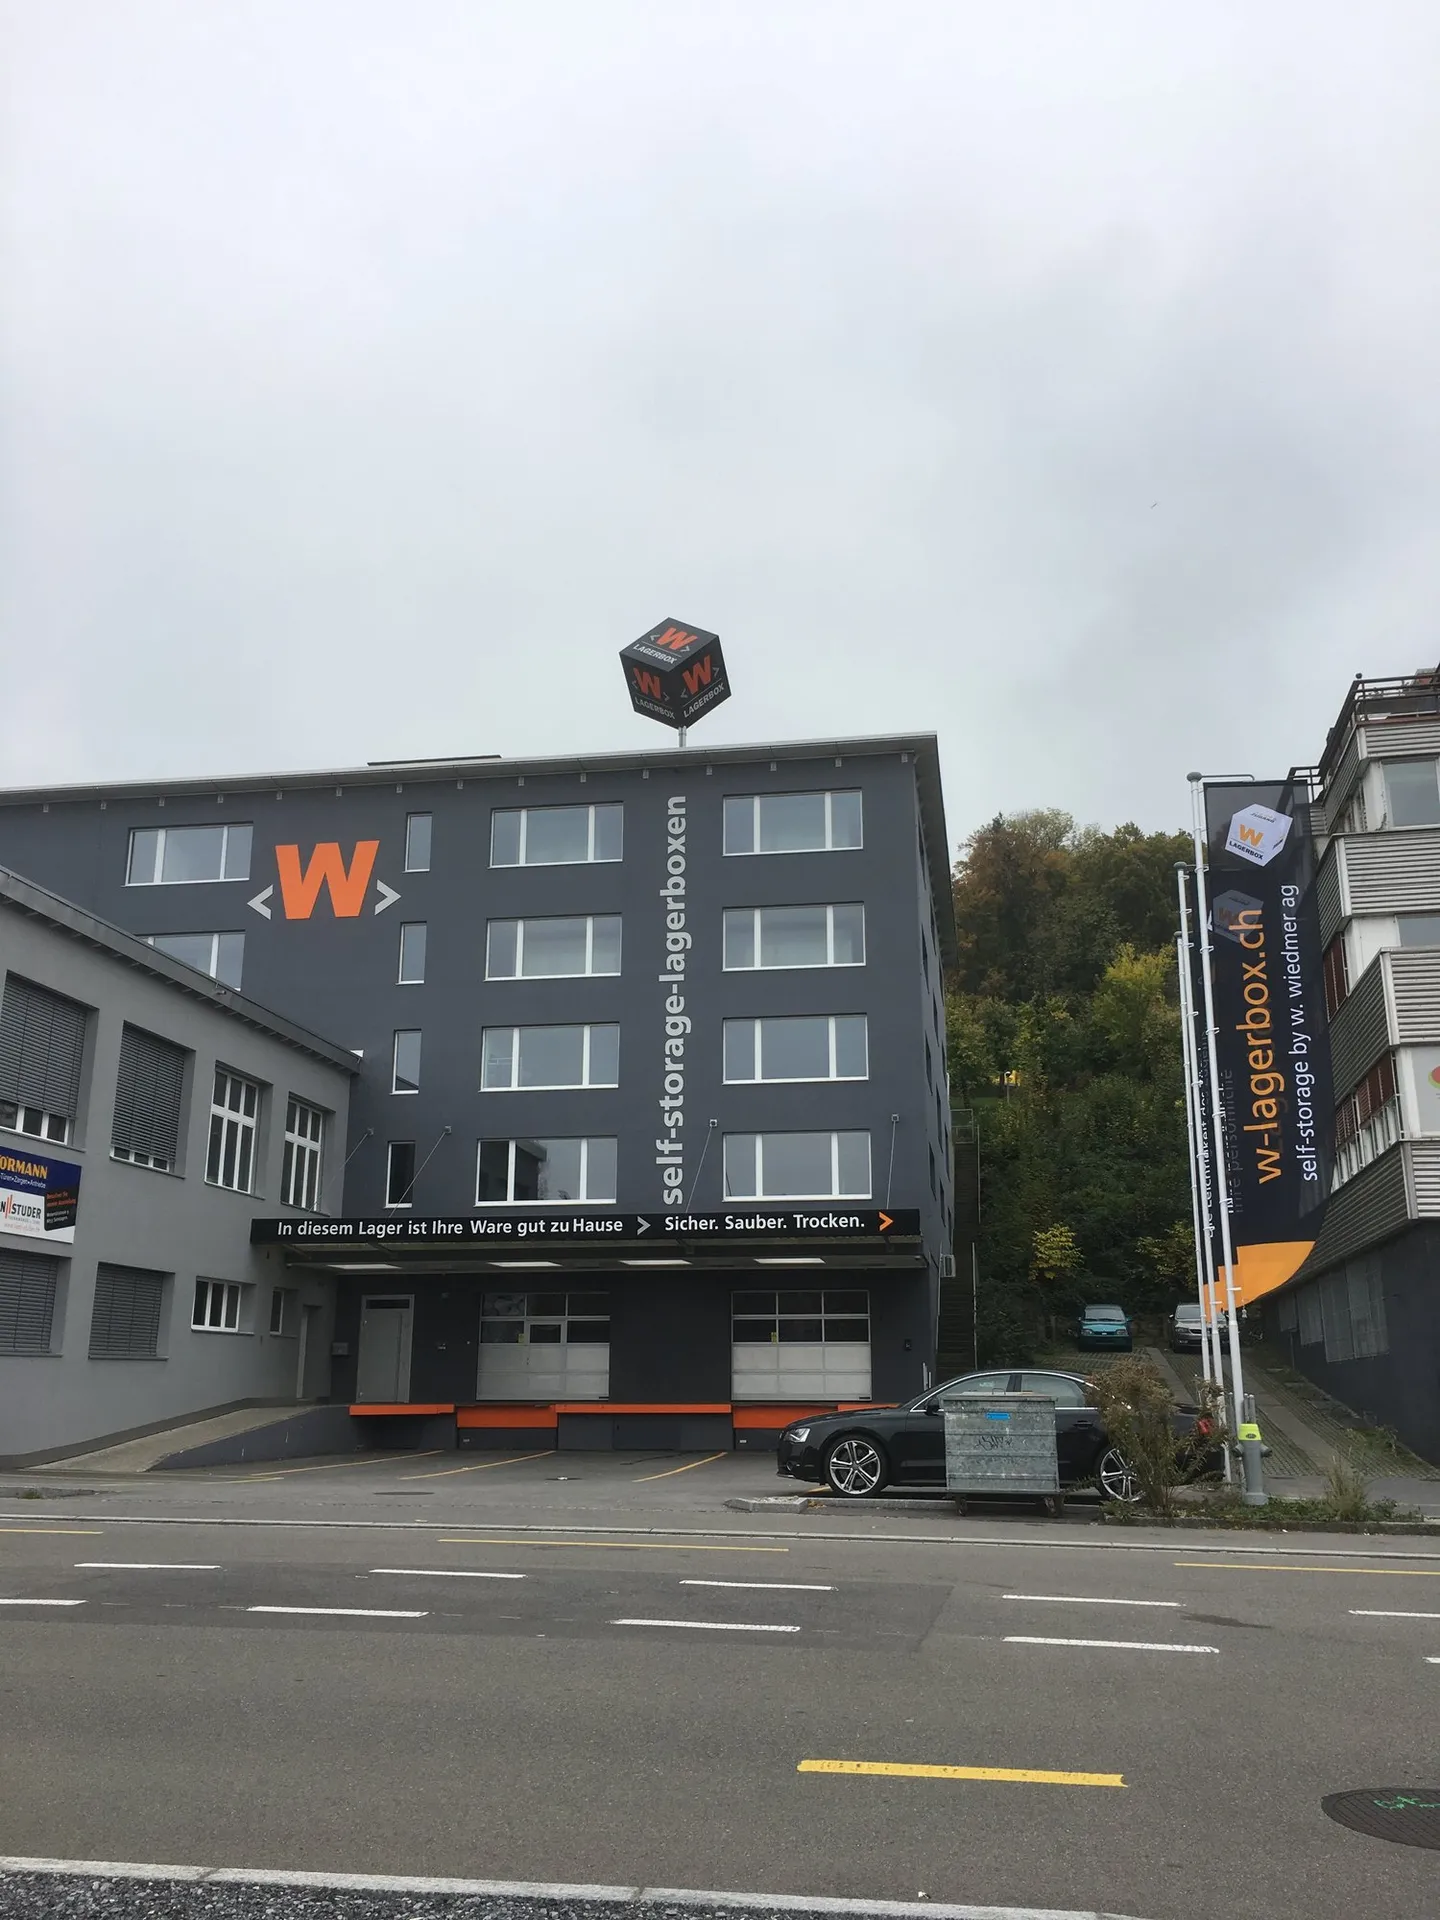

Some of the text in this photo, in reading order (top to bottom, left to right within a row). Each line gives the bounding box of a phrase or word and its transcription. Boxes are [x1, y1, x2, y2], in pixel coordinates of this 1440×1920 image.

[656, 627, 698, 650] W
[633, 644, 677, 664] LAGERBOX
[633, 667, 661, 699] W
[682, 654, 711, 695] W
[634, 697, 676, 719] LAGERBOX
[683, 682, 725, 718] LAGERBOX
[1239, 823, 1264, 847] W
[1229, 841, 1264, 860] LAGERBOX
[275, 840, 380, 920] W
[656, 796, 692, 1204] self-storage-lagerboxen
[1280, 884, 1318, 1181] self-storage by w. wiedmer ag
[1229, 909, 1285, 1184] w-lagerbox.ch
[11, 1202, 42, 1219] STUDER
[664, 1212, 865, 1231] Sicher. Sauber. Trocken.
[277, 1217, 624, 1239] In diesem Lager ist Ihre Ware gut zu Hause
